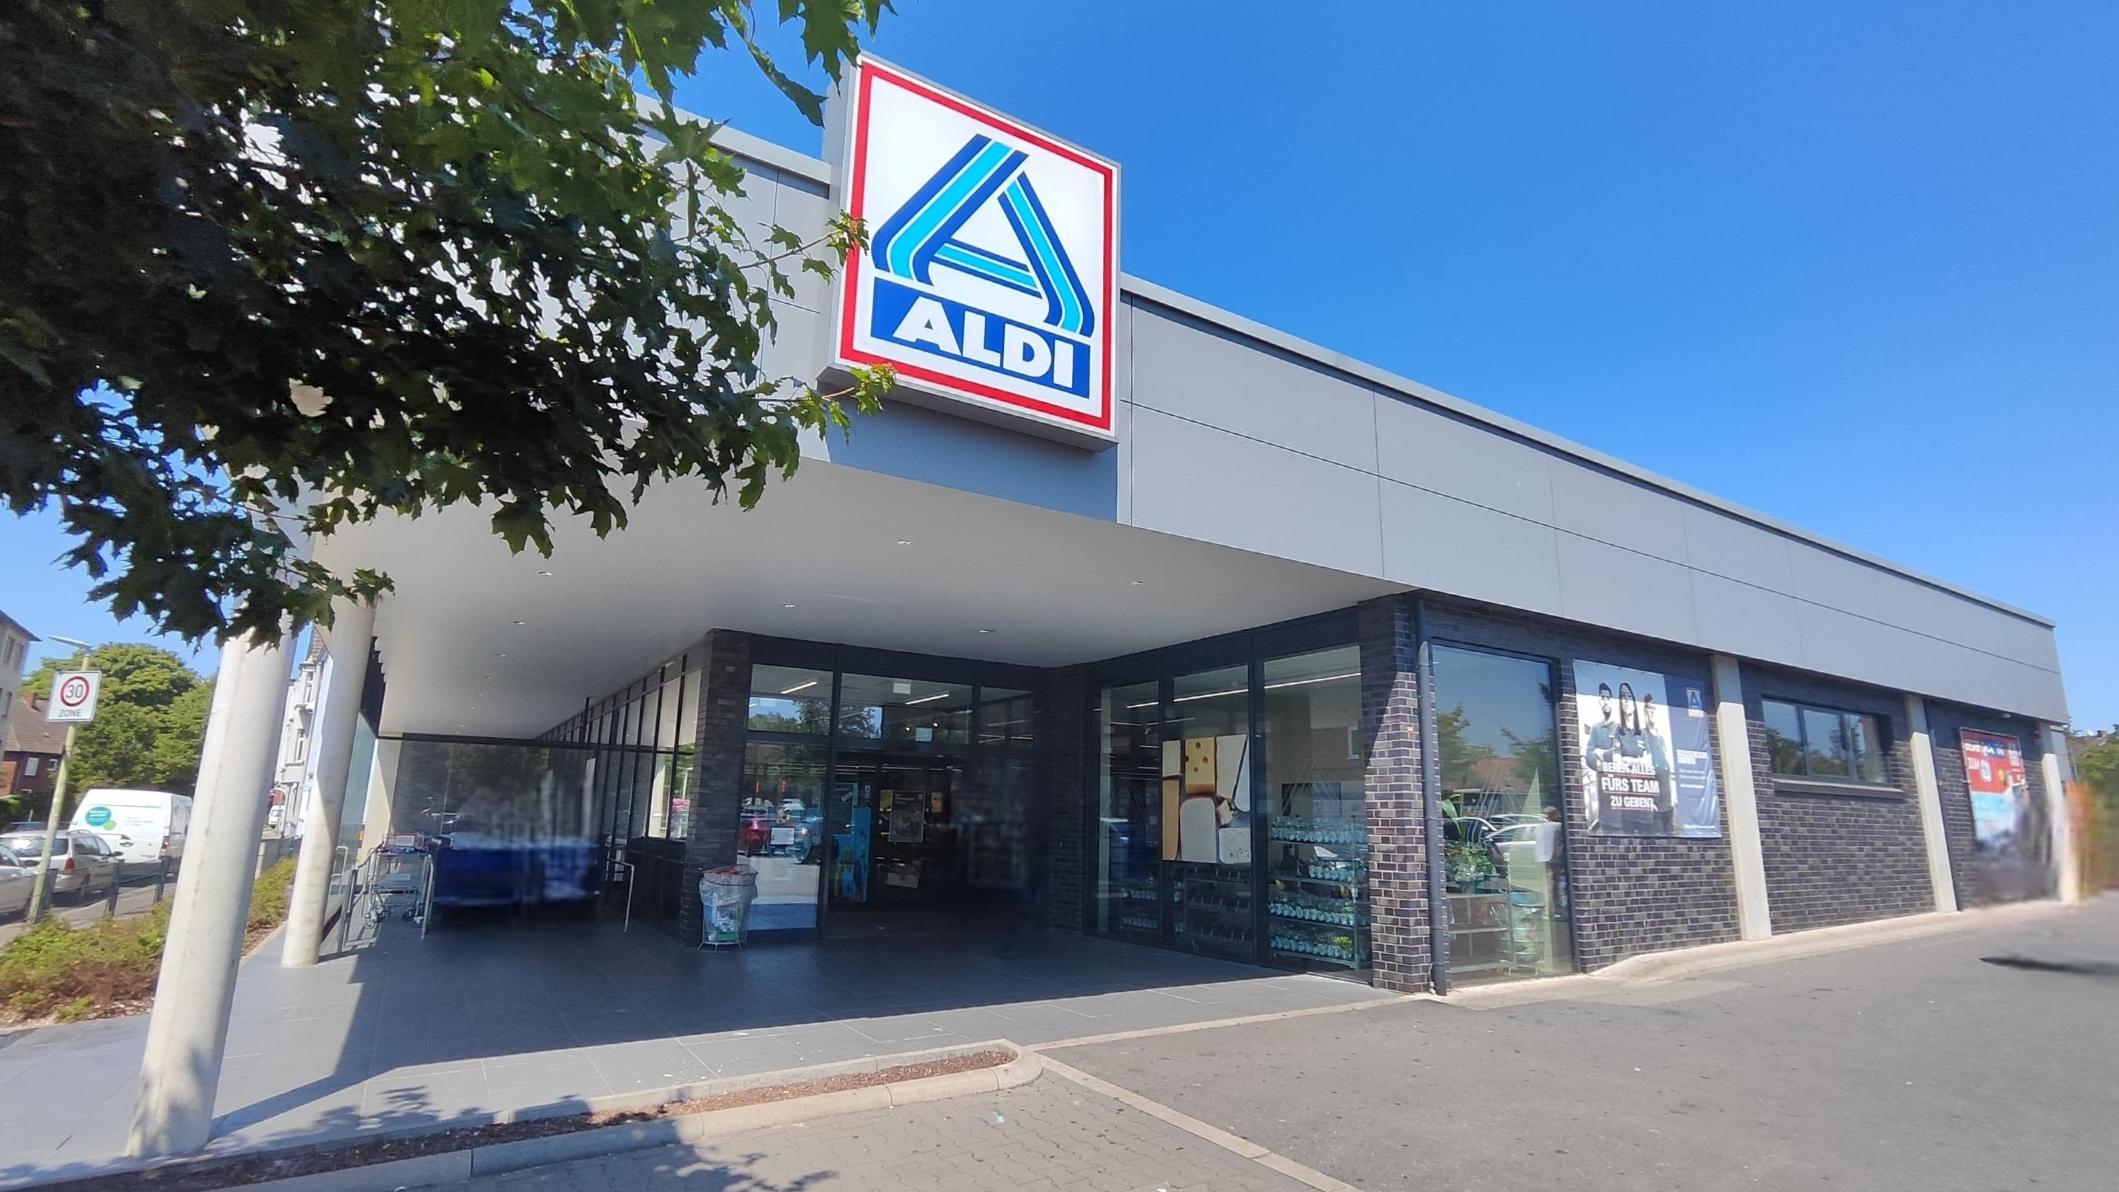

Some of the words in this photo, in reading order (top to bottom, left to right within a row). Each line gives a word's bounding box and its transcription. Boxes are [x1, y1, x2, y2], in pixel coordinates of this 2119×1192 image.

[892, 296, 1074, 389] ALDI
[65, 684, 84, 699] 30
[58, 709, 83, 718] ZONE
[1601, 773, 1629, 792] FÜRS
[1630, 778, 1660, 793] TEAM
[1610, 795, 1622, 807] ZU
